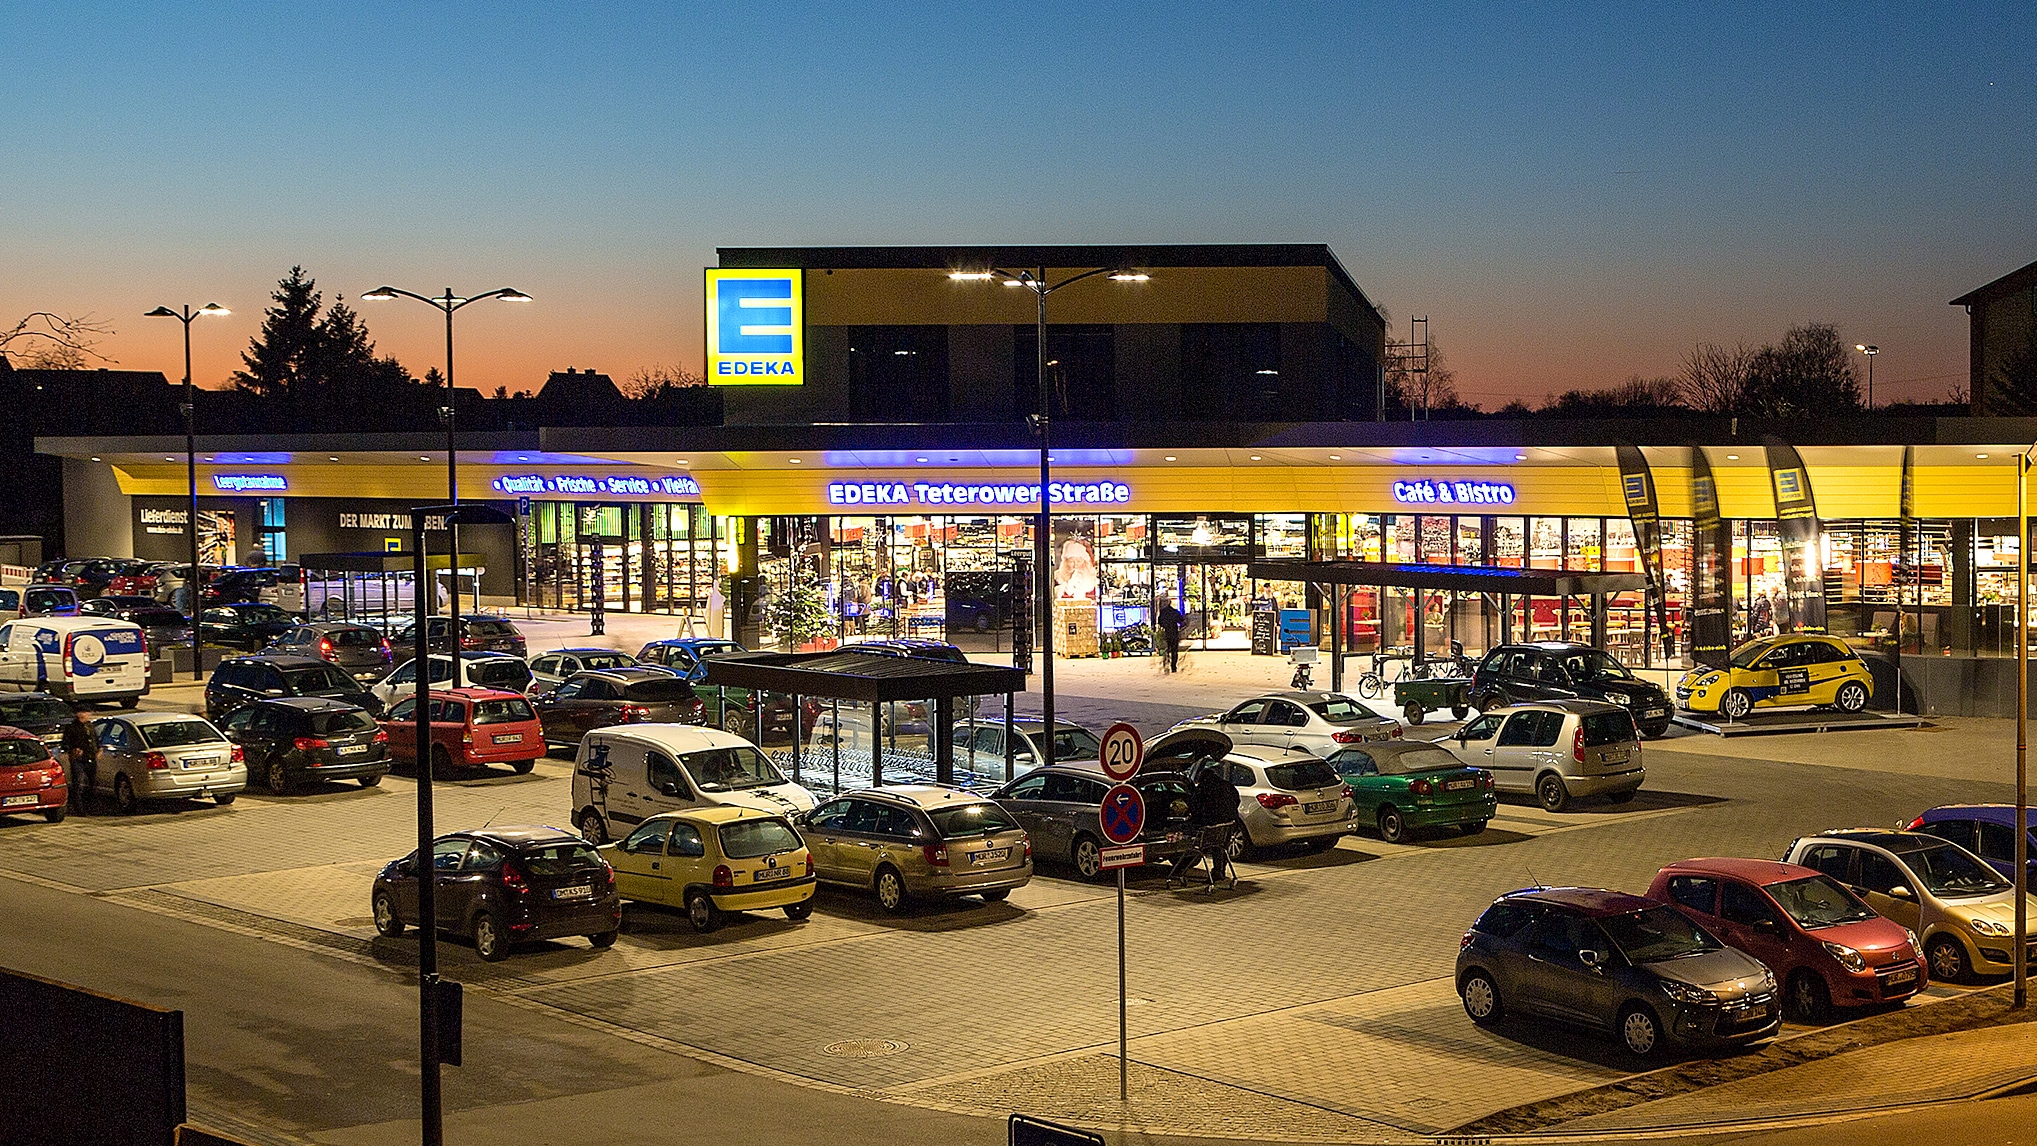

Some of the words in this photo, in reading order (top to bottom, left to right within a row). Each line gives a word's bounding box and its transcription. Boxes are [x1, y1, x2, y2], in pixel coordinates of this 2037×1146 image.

[719, 361, 794, 375] EDEKA
[502, 475, 546, 494] Qualität
[555, 476, 597, 493] Frische
[608, 477, 650, 494] Service
[661, 477, 700, 495] Vielfa
[829, 483, 910, 505] EDEKA
[913, 482, 1041, 503] Teterower
[1050, 481, 1129, 503] Straße
[1394, 480, 1436, 503] Café
[1438, 482, 1455, 503] &
[1455, 482, 1514, 504] Bistro
[521, 498, 528, 514] P
[140, 508, 189, 524] Lieferdienst
[340, 513, 358, 528] DER
[359, 513, 391, 529] MARKT
[392, 514, 413, 530] ZUM
[1109, 738, 1134, 765] 20
